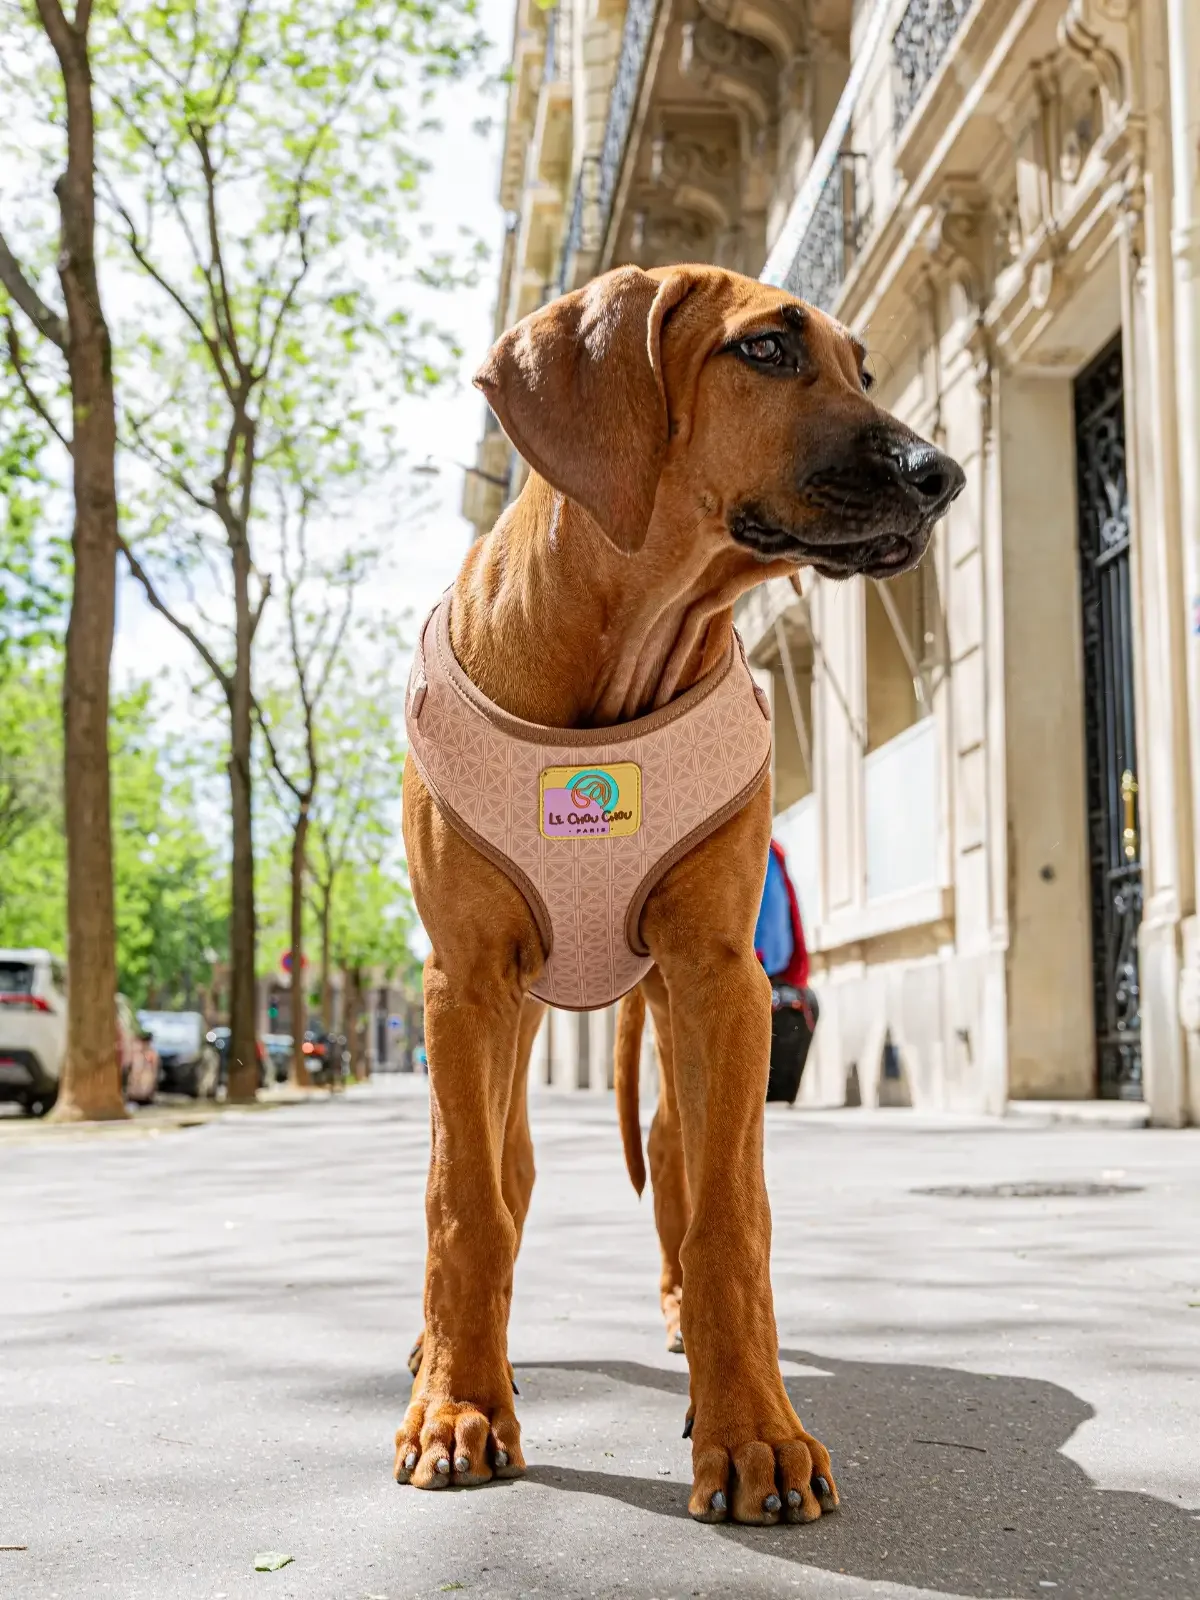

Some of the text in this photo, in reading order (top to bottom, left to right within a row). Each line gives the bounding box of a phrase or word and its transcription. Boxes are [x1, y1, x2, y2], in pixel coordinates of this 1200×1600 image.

[549, 810, 632, 825] LE CHOU CHOU
